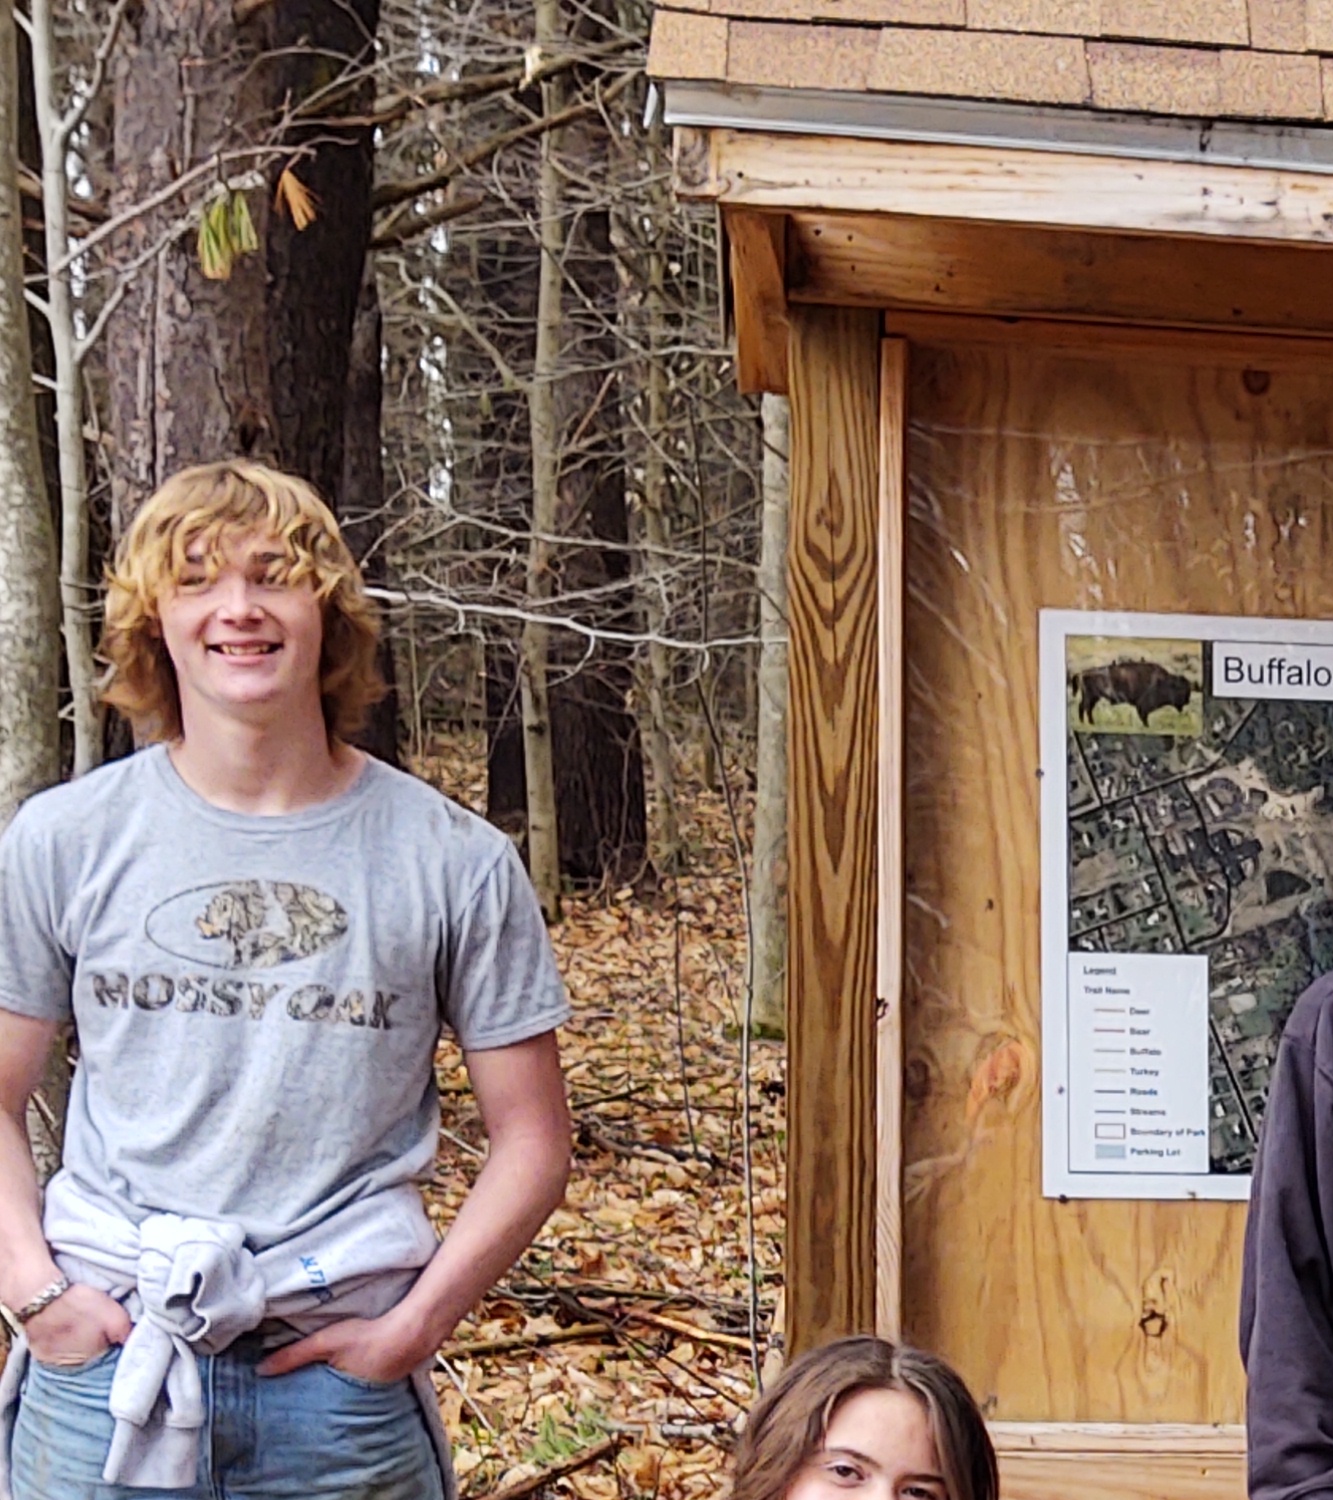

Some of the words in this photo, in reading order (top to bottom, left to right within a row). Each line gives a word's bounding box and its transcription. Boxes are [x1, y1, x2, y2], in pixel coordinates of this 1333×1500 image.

[1223, 656, 1332, 686] Buffalo
[1083, 966, 1117, 976] Legend
[92, 972, 285, 1020] MOSSY
[286, 983, 399, 1030] OAK
[1129, 1047, 1162, 1056] Buffalo
[1130, 1067, 1160, 1077] Turkey
[1175, 1128, 1184, 1137] of
[1130, 1147, 1164, 1158] Parking
[1166, 1148, 1181, 1157] Lot
